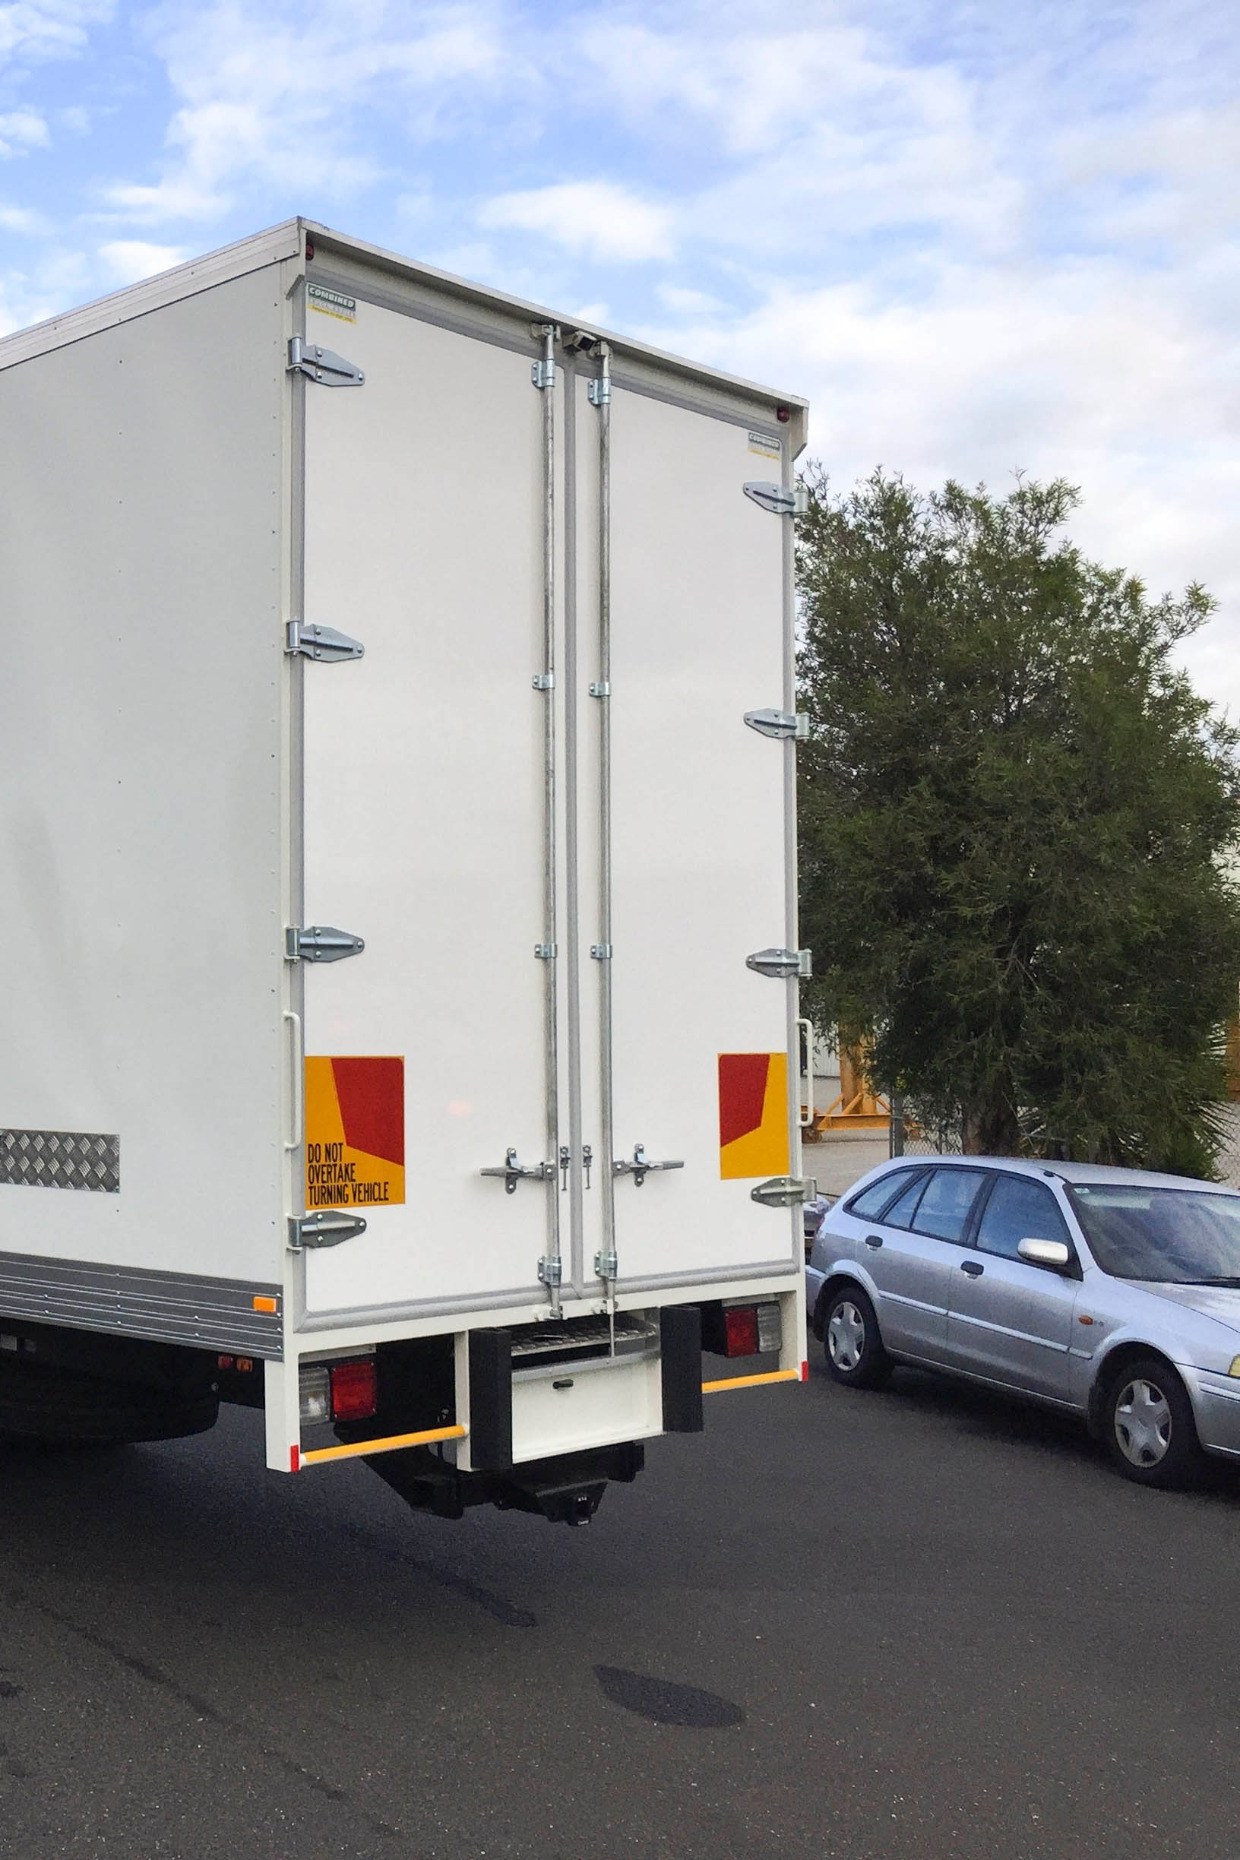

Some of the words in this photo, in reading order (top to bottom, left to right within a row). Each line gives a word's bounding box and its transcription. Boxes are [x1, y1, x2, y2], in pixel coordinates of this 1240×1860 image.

[309, 287, 354, 308] COMBINED
[308, 1143, 321, 1163] DO
[325, 1142, 343, 1162] NOT
[308, 1163, 356, 1184] OVERTAKE
[308, 1184, 349, 1206] TURNING
[351, 1181, 389, 1202] VEHICLE
